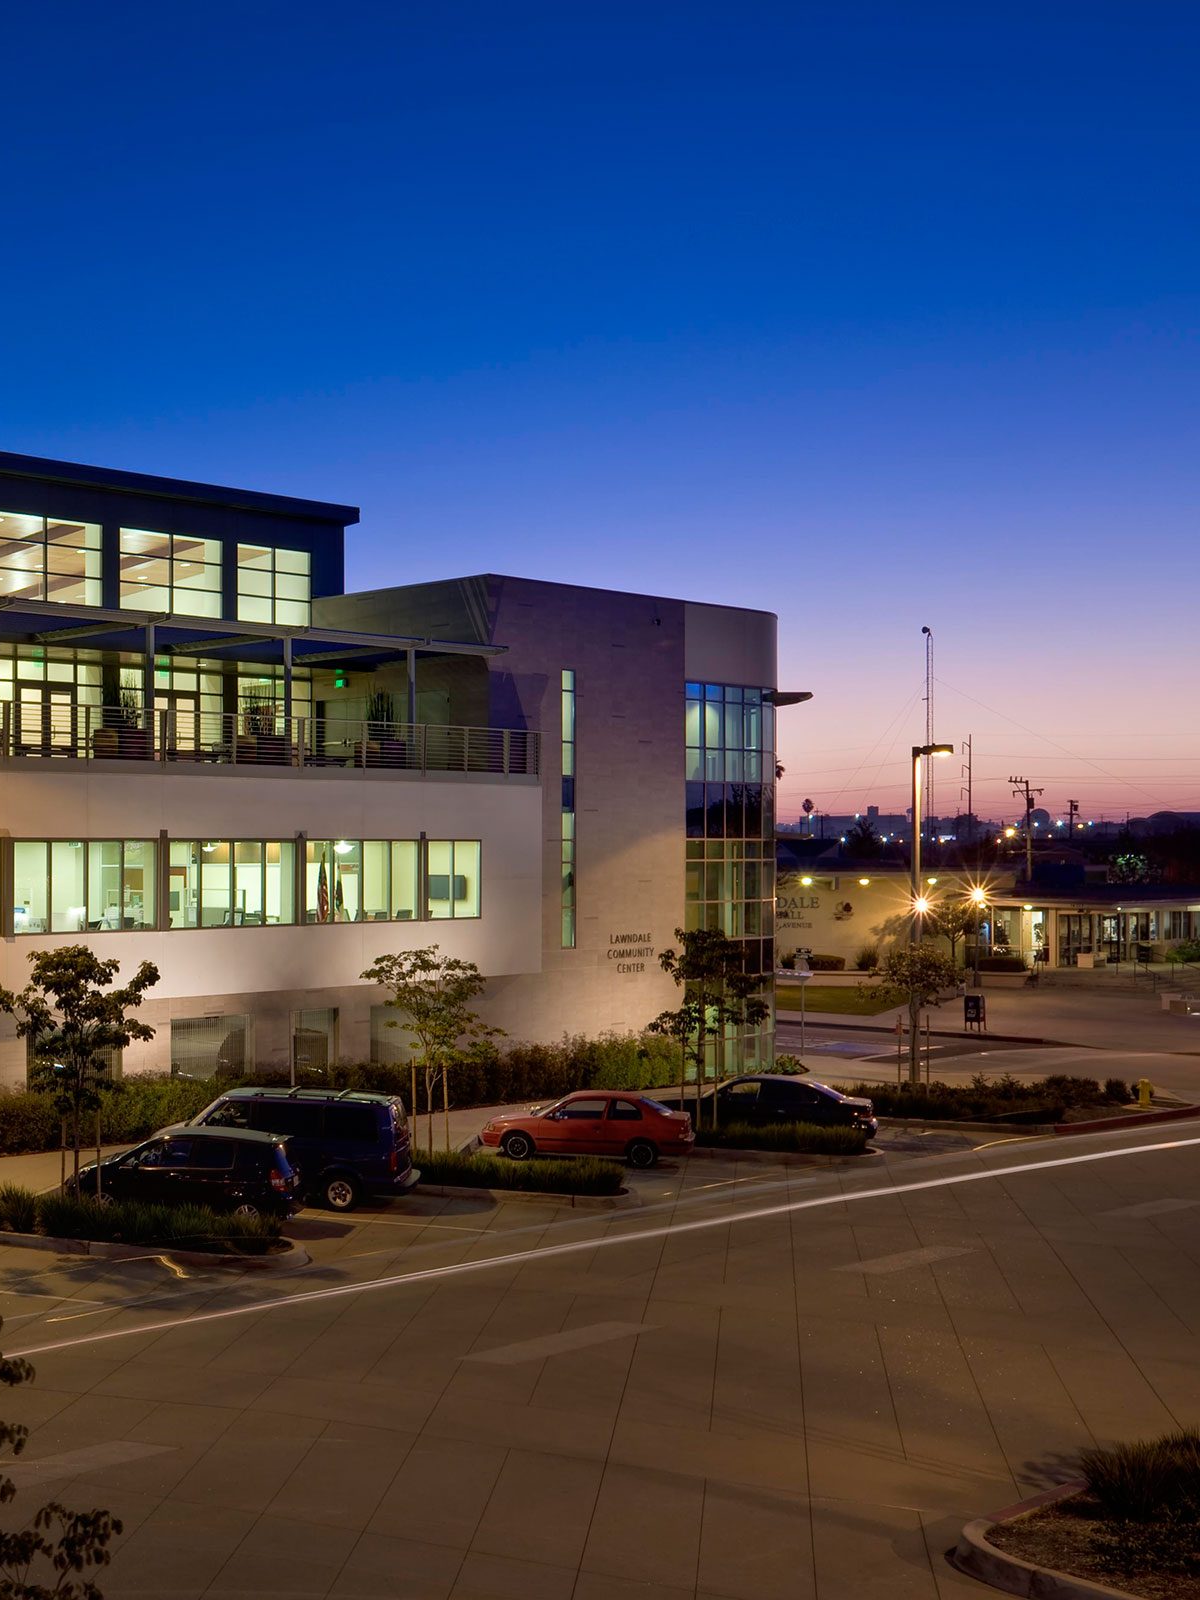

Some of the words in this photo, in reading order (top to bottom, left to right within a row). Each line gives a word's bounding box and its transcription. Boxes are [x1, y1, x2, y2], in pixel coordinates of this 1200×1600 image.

[610, 932, 651, 944] LAWNDALE
[607, 946, 654, 959] COMMUNITY
[617, 962, 645, 973] CENTER
